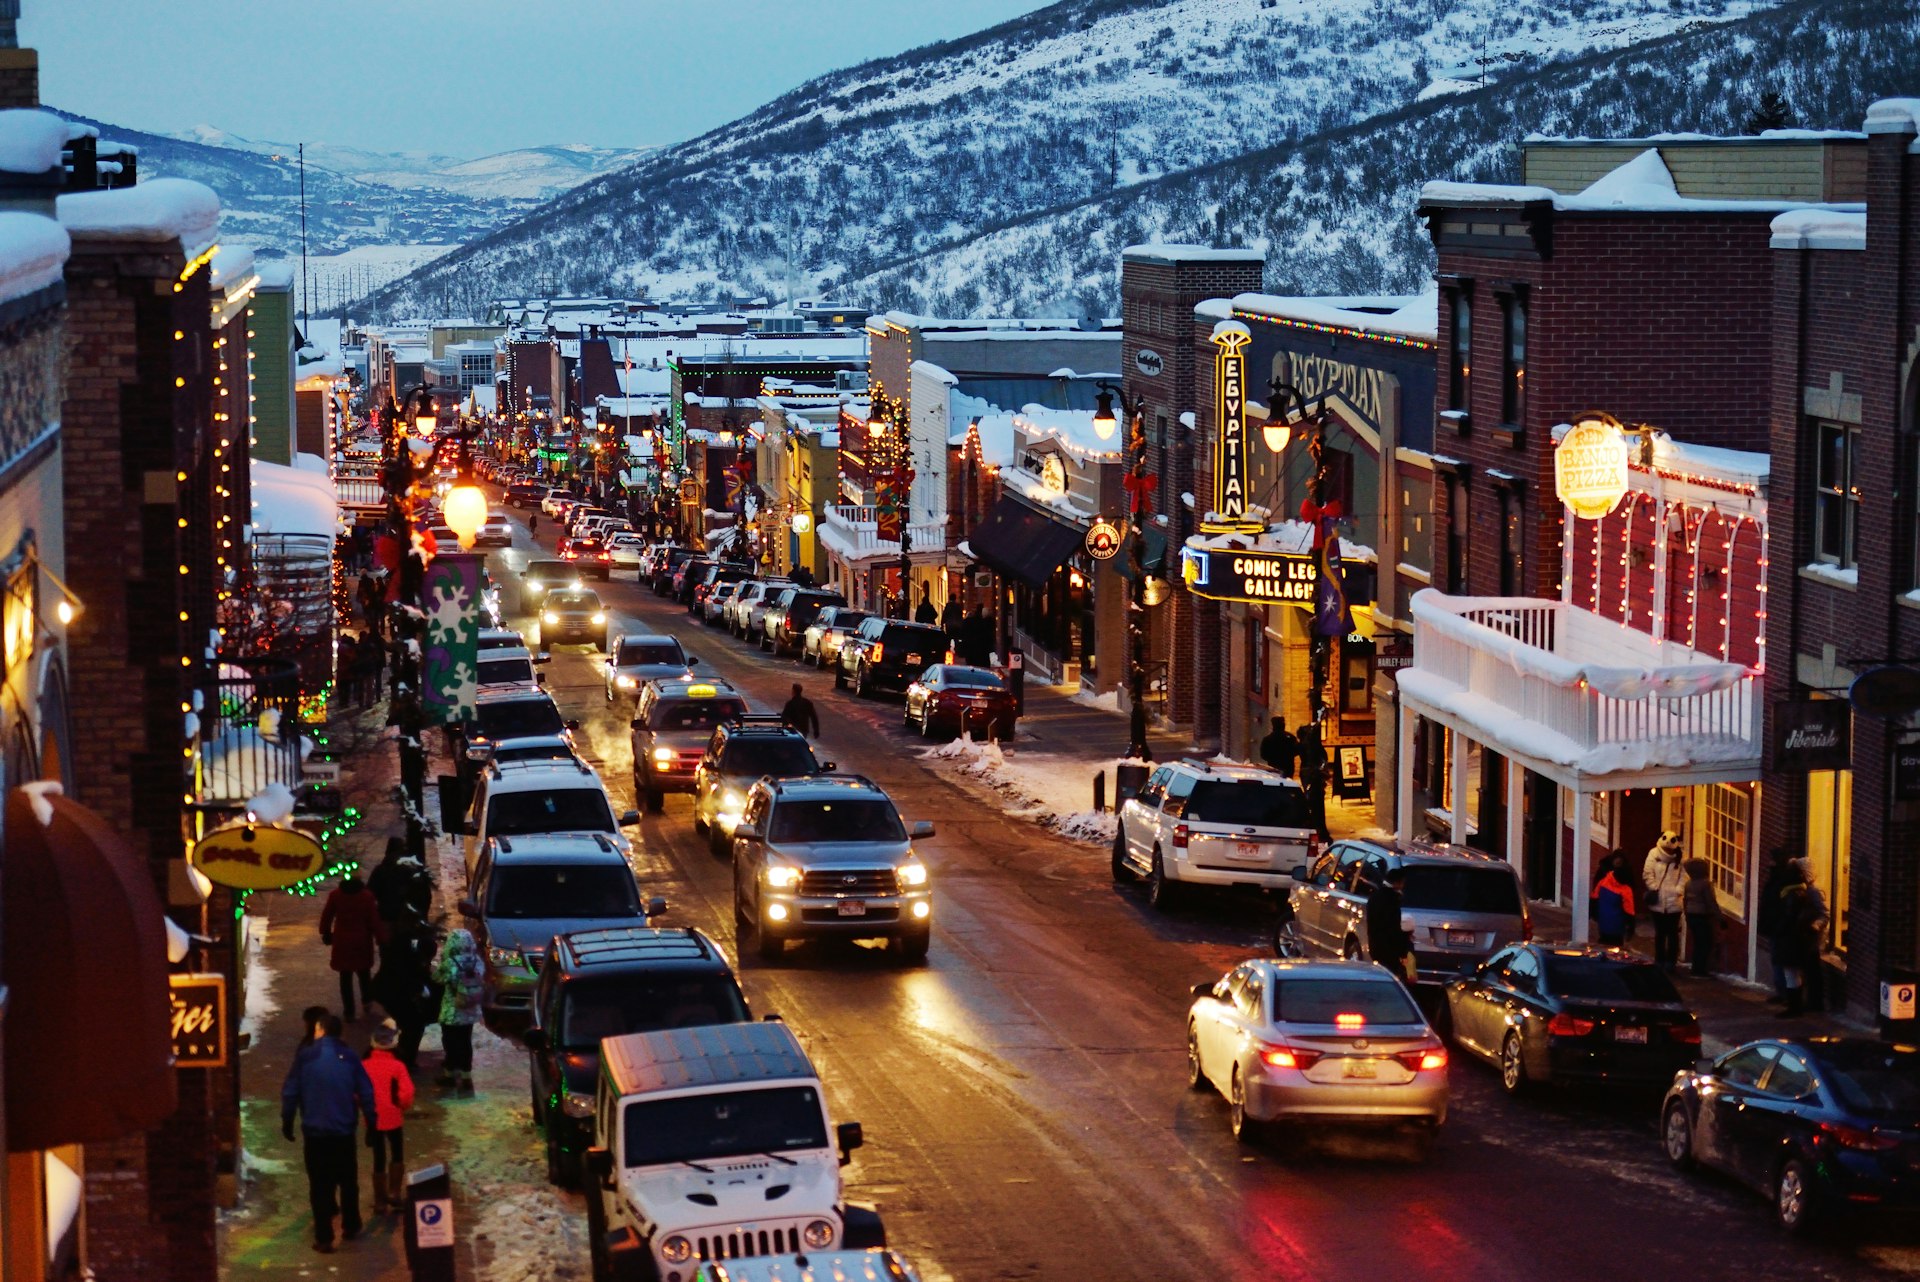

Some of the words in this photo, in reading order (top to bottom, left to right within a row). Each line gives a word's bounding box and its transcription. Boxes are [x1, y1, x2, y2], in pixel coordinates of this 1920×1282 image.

[1288, 351, 1384, 424] EGYPTIAN
[1225, 359, 1242, 516] EGYPTIAN
[1575, 429, 1604, 447] RED
[1562, 447, 1620, 468] BANJO
[1563, 468, 1621, 489] PIZZA
[1233, 557, 1281, 578] COMIC
[1785, 729, 1838, 749] Jiberish
